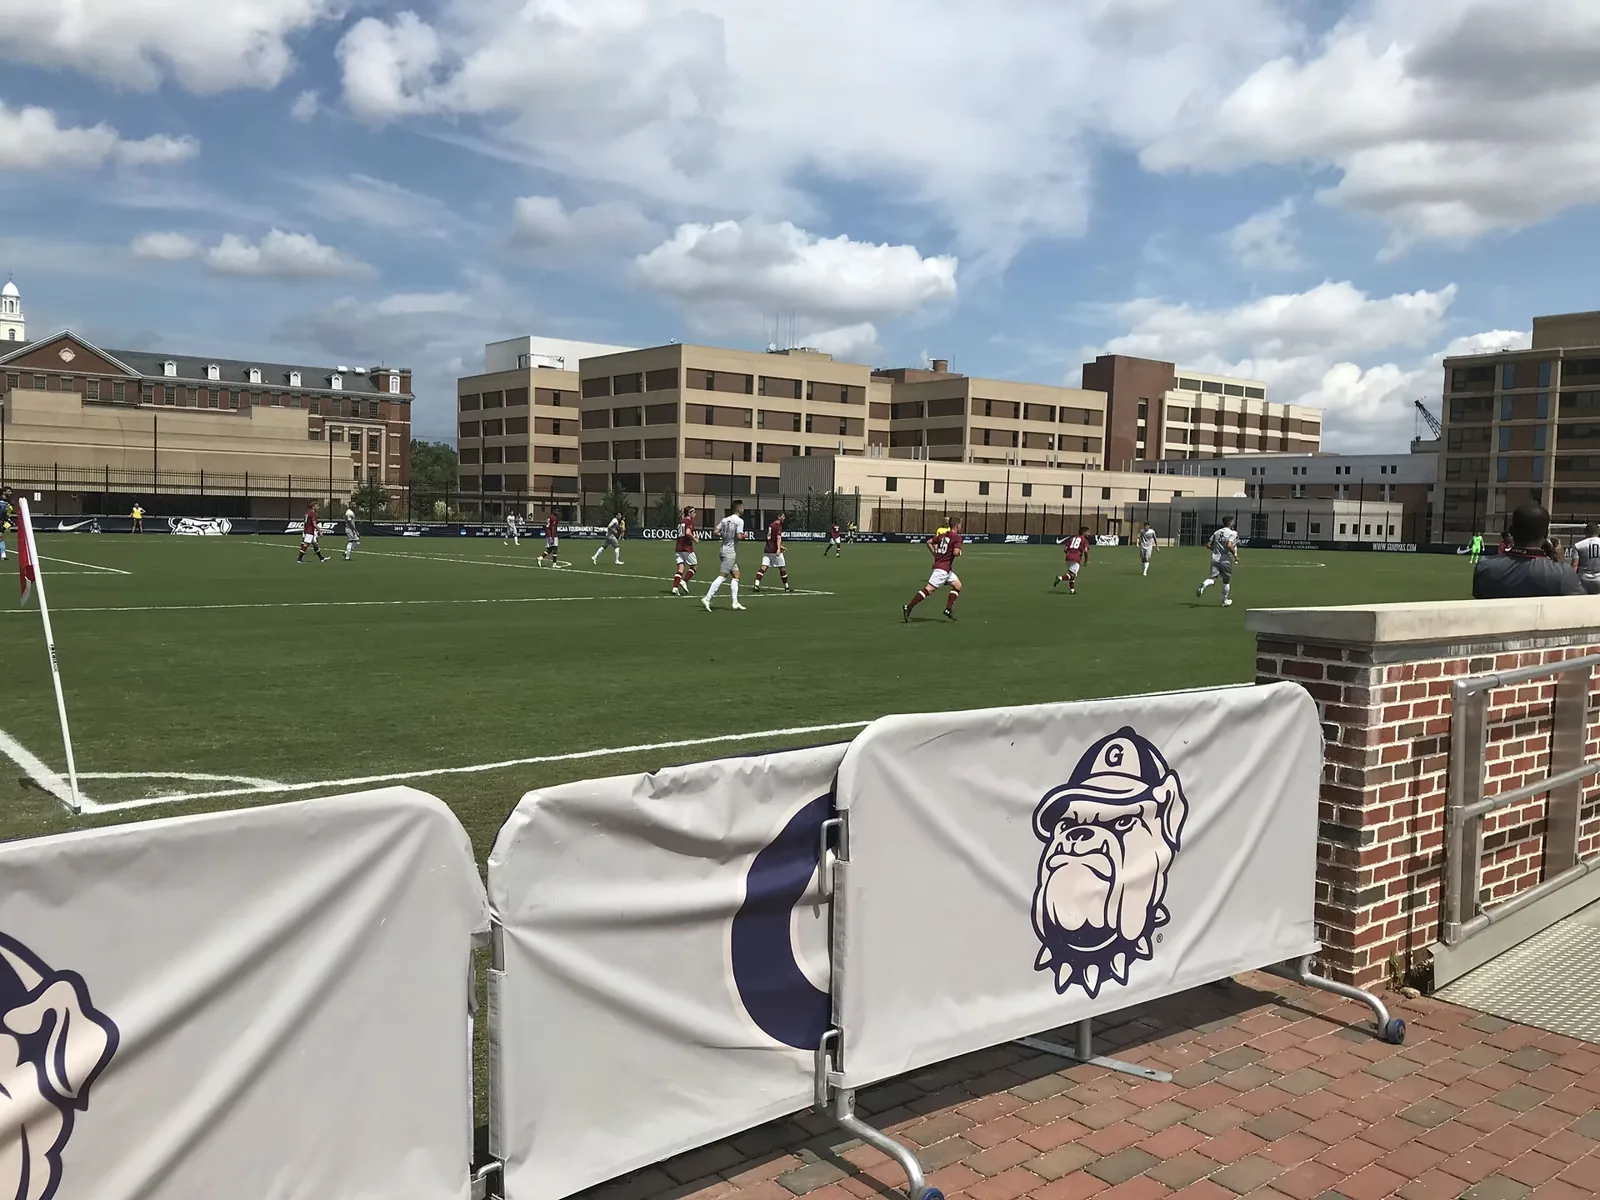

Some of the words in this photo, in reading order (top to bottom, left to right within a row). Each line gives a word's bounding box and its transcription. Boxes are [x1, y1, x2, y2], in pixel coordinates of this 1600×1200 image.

[643, 528, 712, 539] GEORGWN
[1070, 537, 1081, 549] 18
[1588, 543, 1599, 558] 10
[1104, 743, 1124, 768] G
